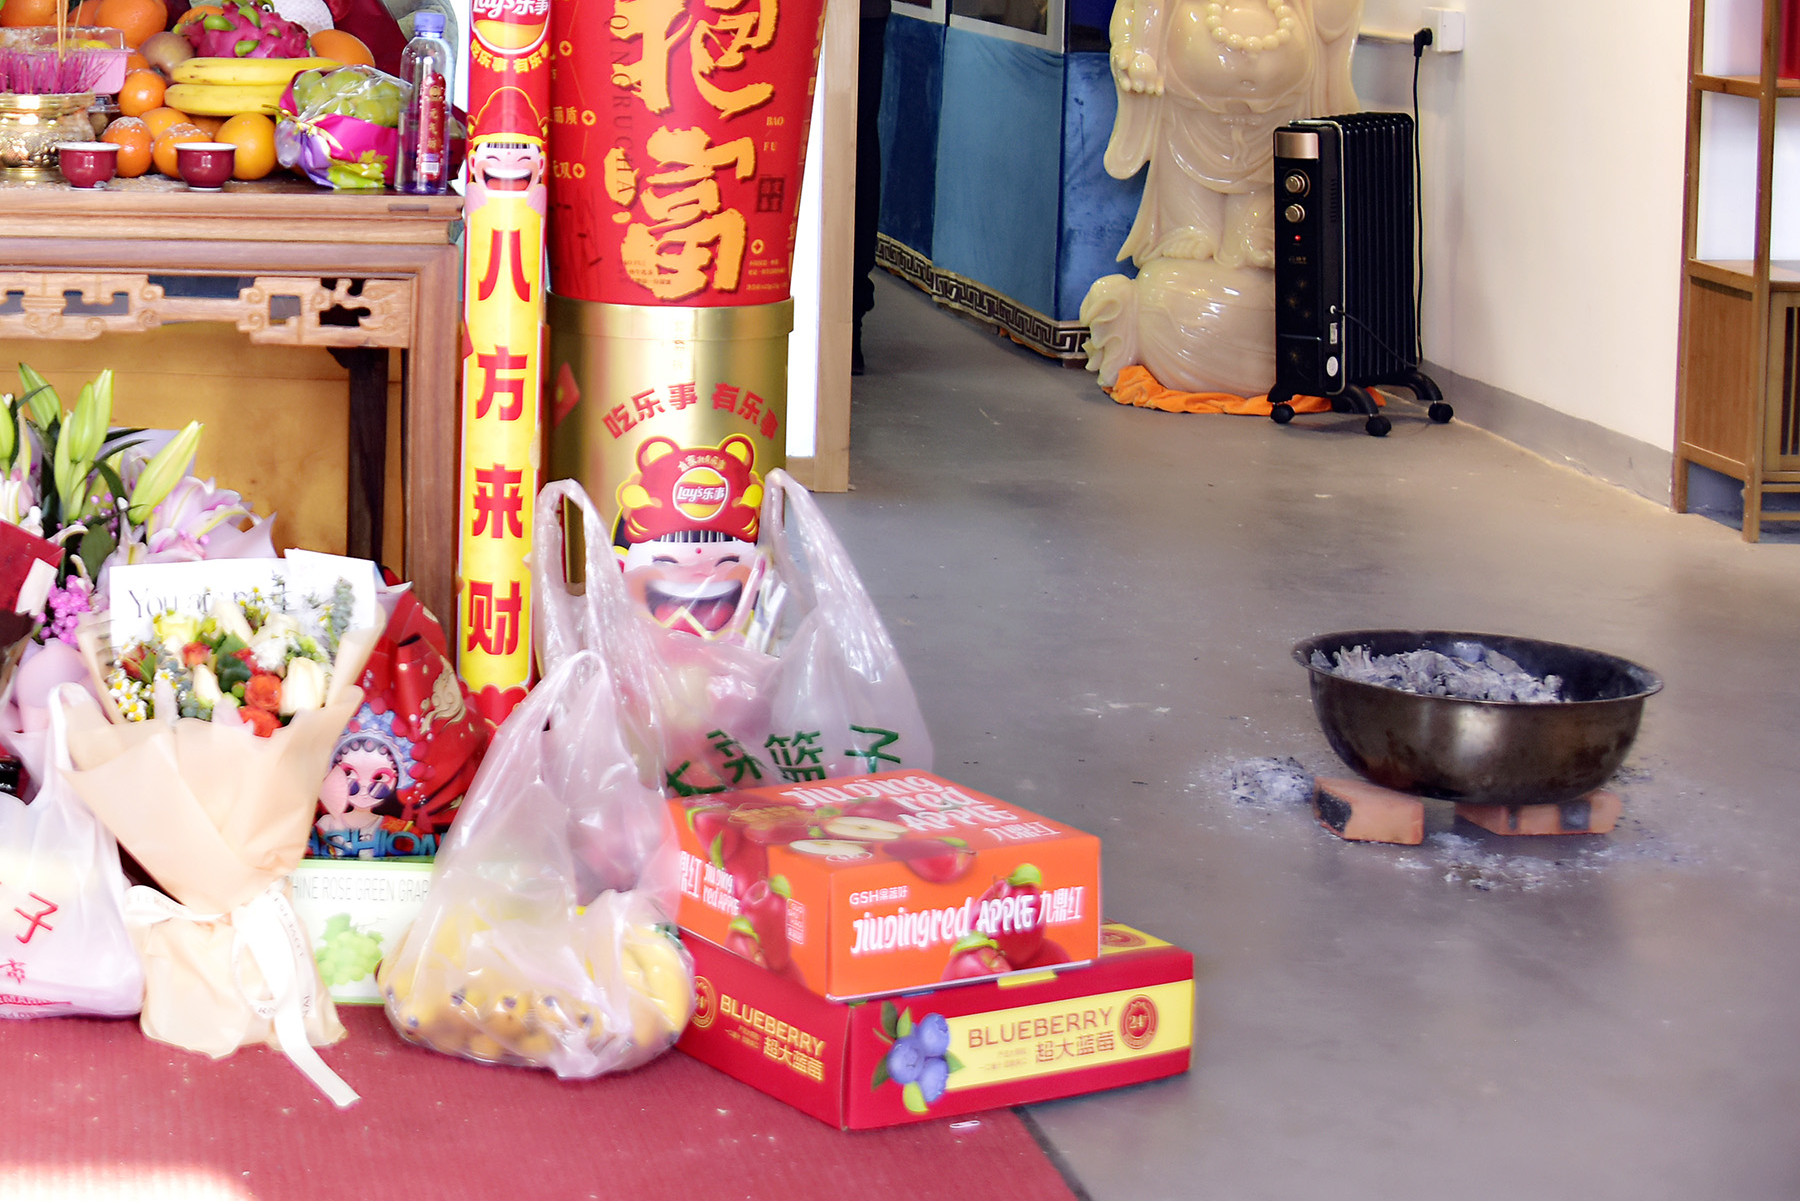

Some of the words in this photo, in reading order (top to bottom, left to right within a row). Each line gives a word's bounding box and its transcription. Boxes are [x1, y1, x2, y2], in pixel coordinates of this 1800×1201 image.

[601, 381, 698, 439] 吃乐事
[711, 382, 780, 440] 有乐事
[466, 229, 531, 657] 八方来财
[1036, 885, 1084, 925] 九鼎红
[719, 993, 826, 1057] BLUEBERRY
[967, 1005, 1114, 1049] BLUEBERRY
[1035, 1030, 1115, 1063] 超大蓝莓
[762, 1035, 825, 1082] 超大蓝莓
